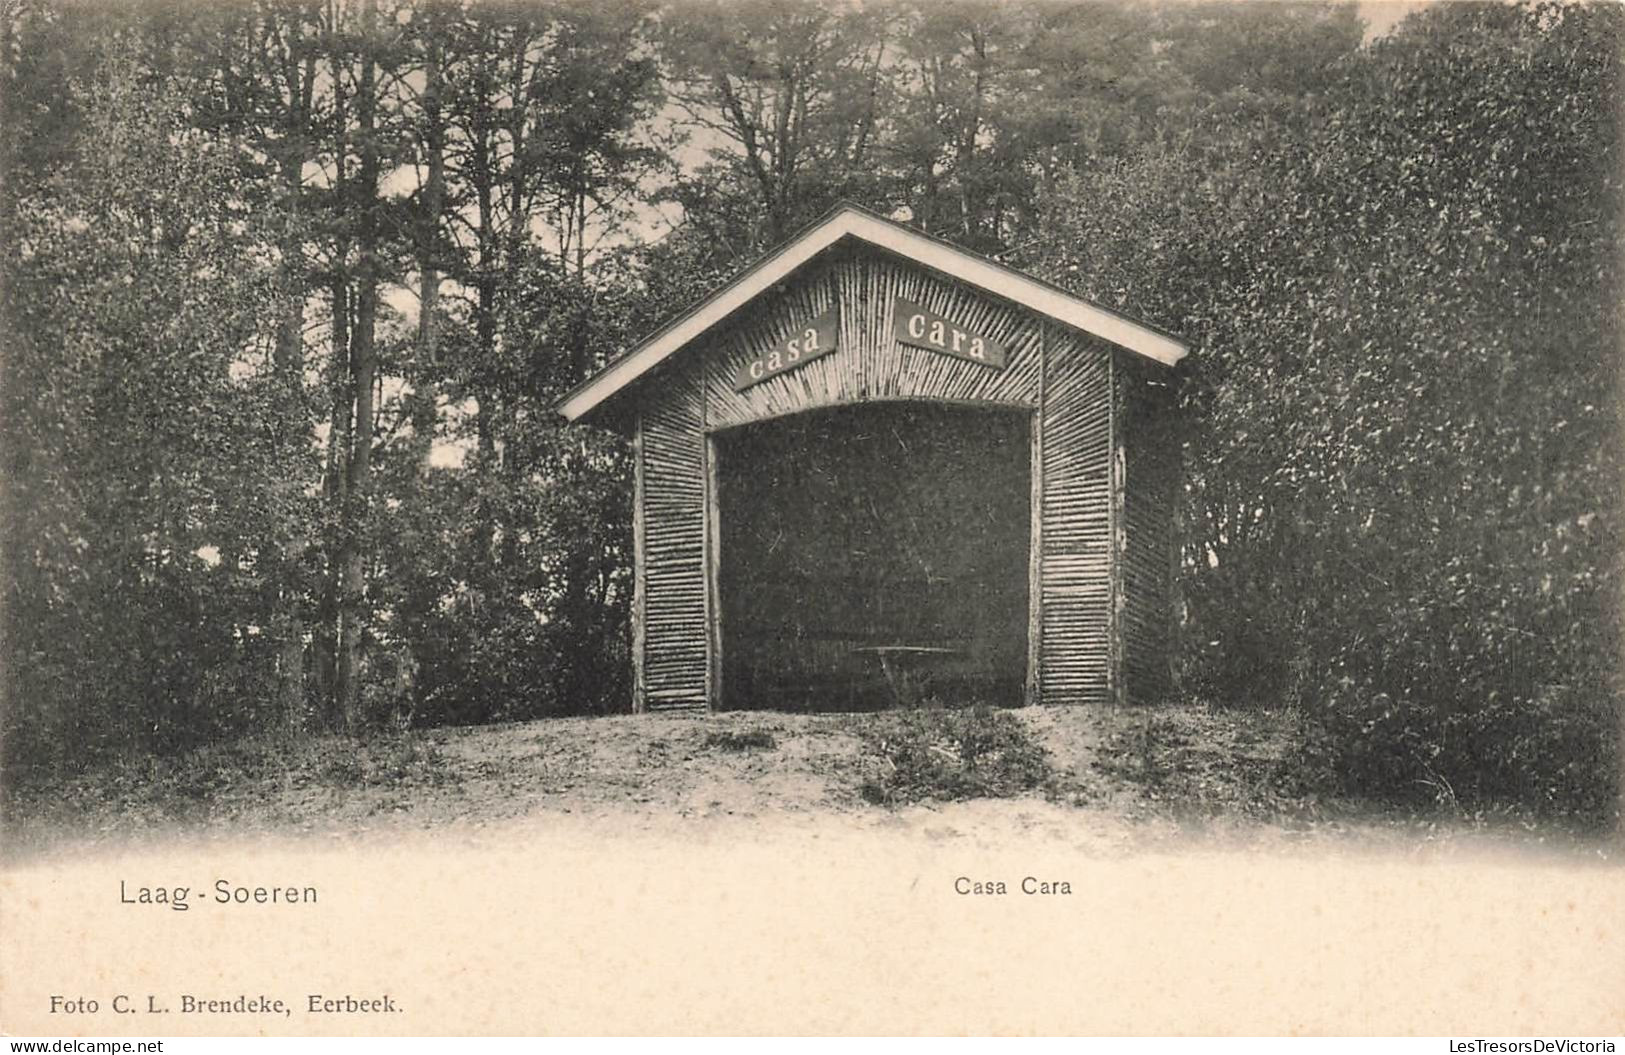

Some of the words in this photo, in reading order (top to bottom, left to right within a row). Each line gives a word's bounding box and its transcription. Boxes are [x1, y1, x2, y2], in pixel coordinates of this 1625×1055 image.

[954, 876, 1007, 895] Casa
[1021, 876, 1072, 895] Cara
[50, 995, 99, 1014] Foto
[112, 995, 136, 1014] C.
[148, 995, 169, 1013] L.
[181, 995, 291, 1017] Brendeke,
[308, 995, 403, 1013] Eerbeek.
